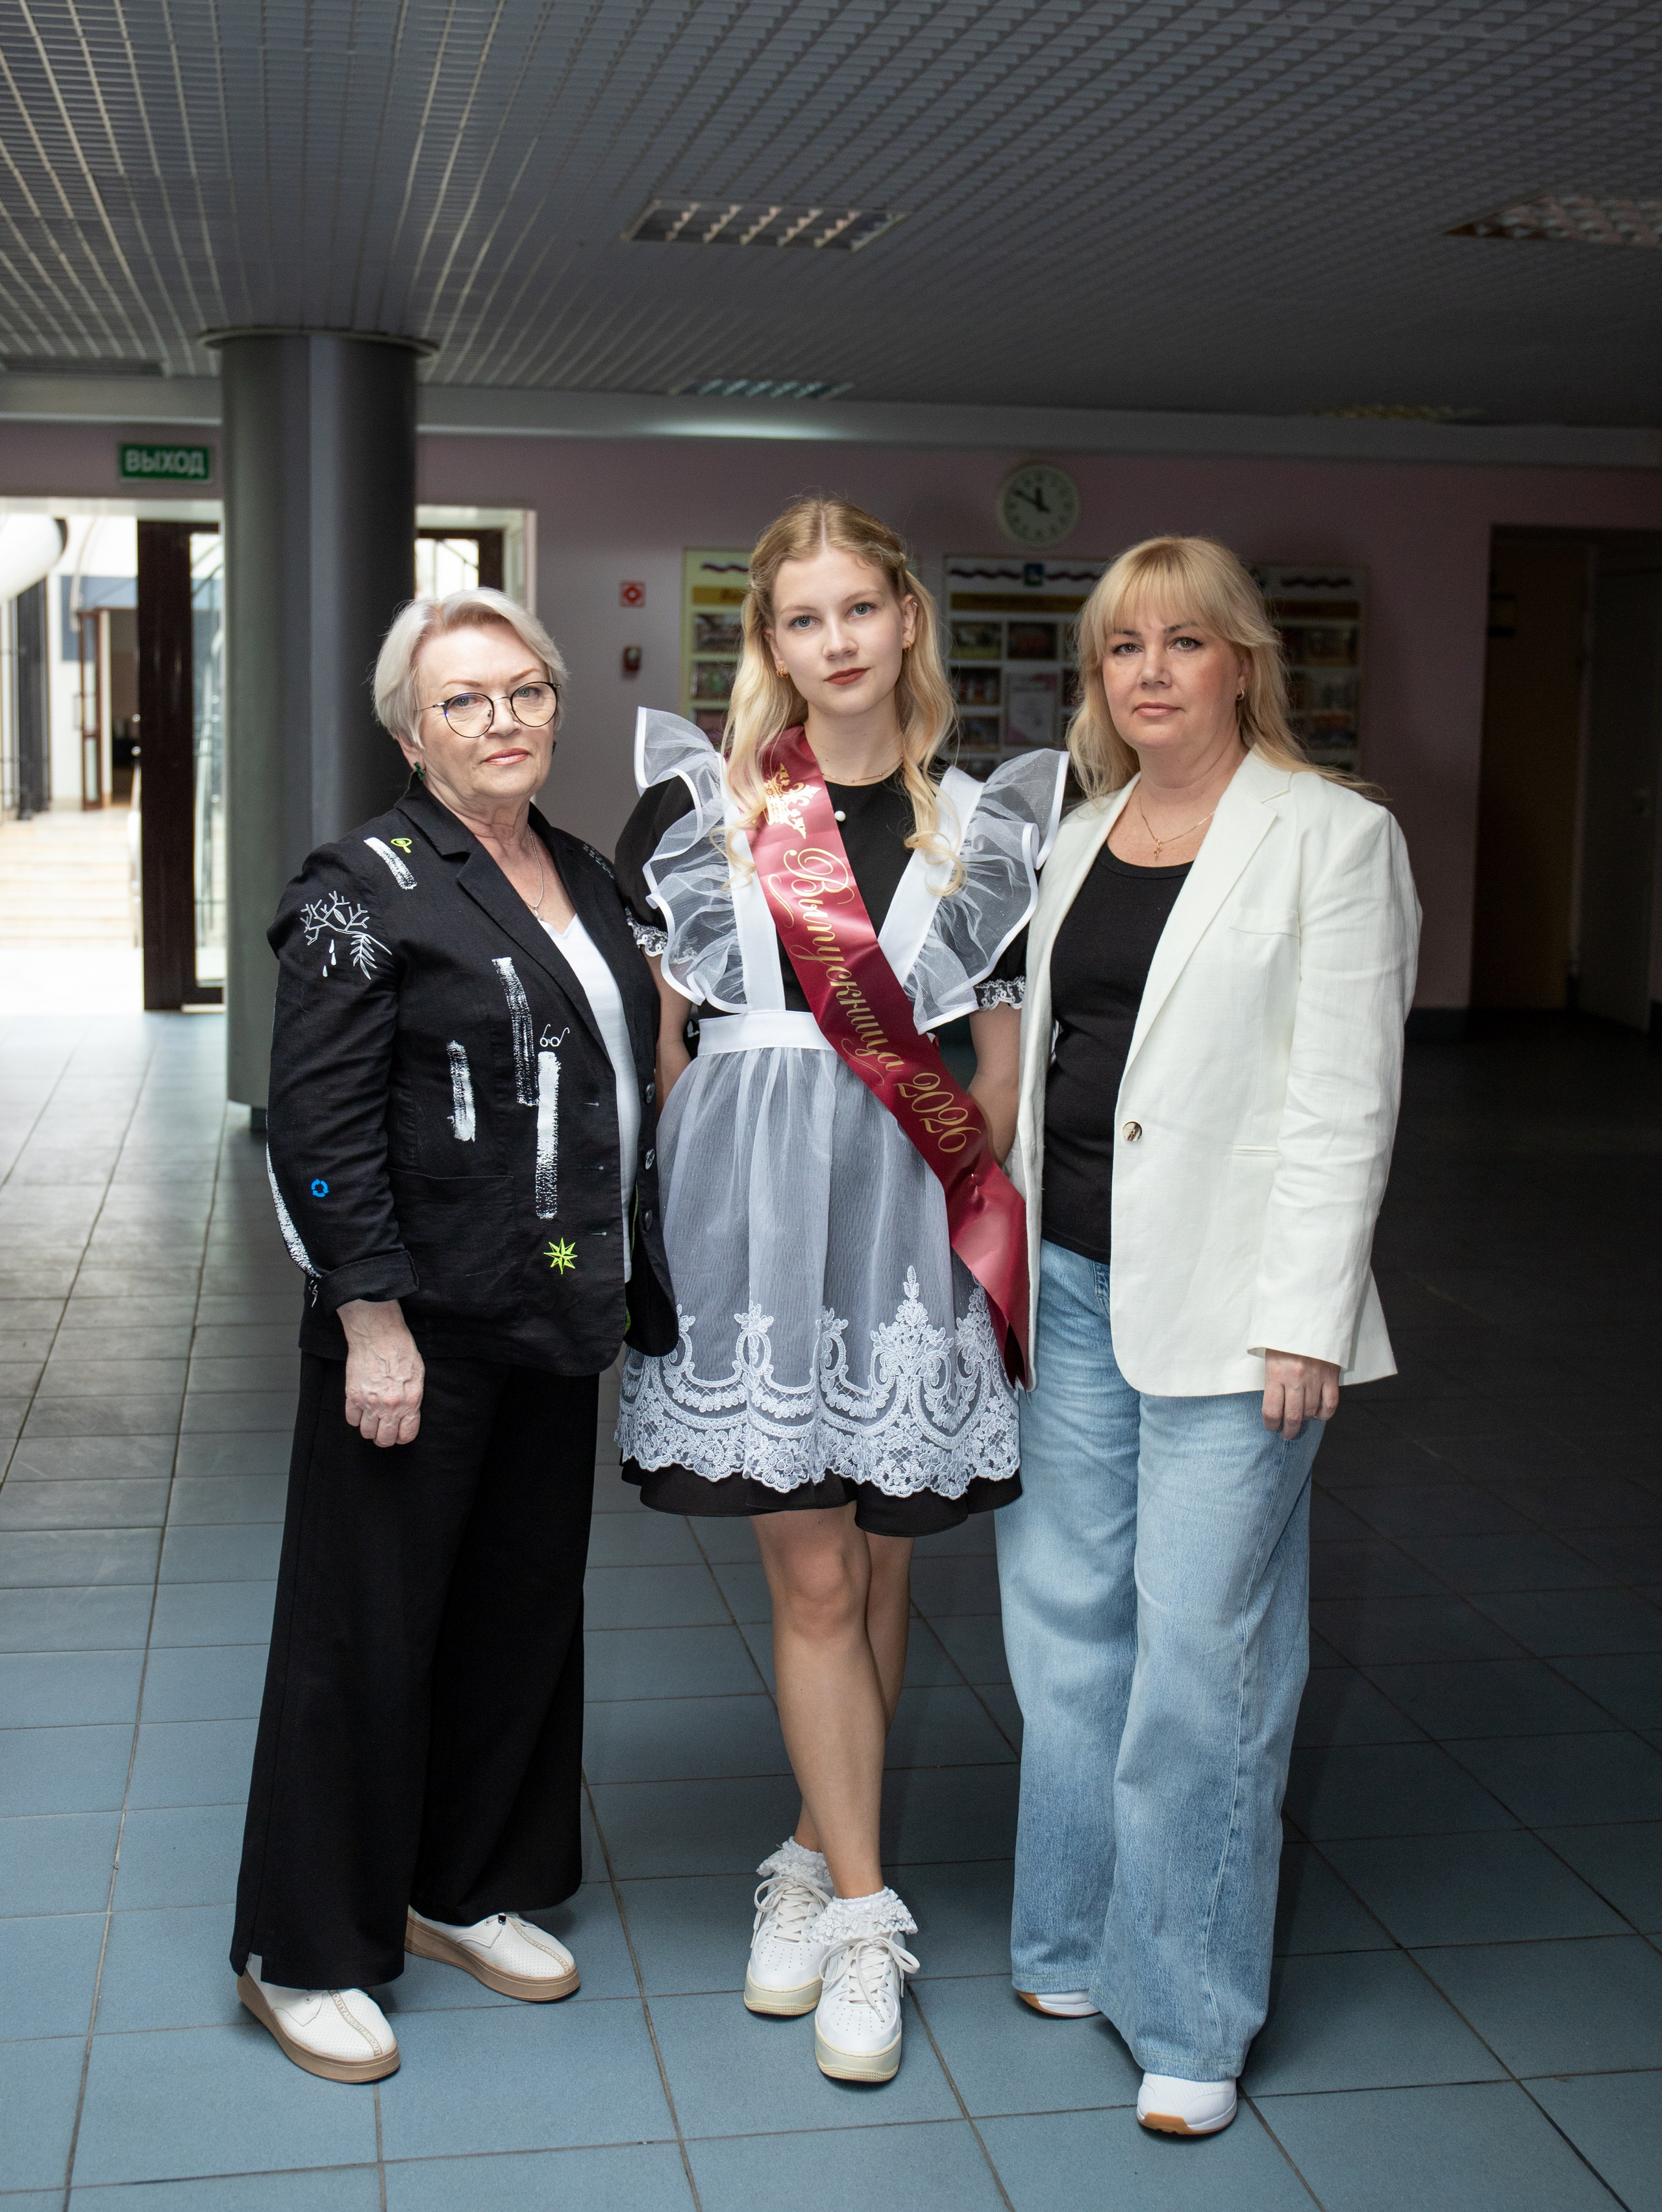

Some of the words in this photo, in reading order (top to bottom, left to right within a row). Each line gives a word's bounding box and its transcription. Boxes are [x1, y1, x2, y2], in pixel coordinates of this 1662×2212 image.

[126, 449, 205, 476] ВЫХОД
[768, 847, 905, 1086] Выпускница
[893, 1072, 982, 1153] 2026
